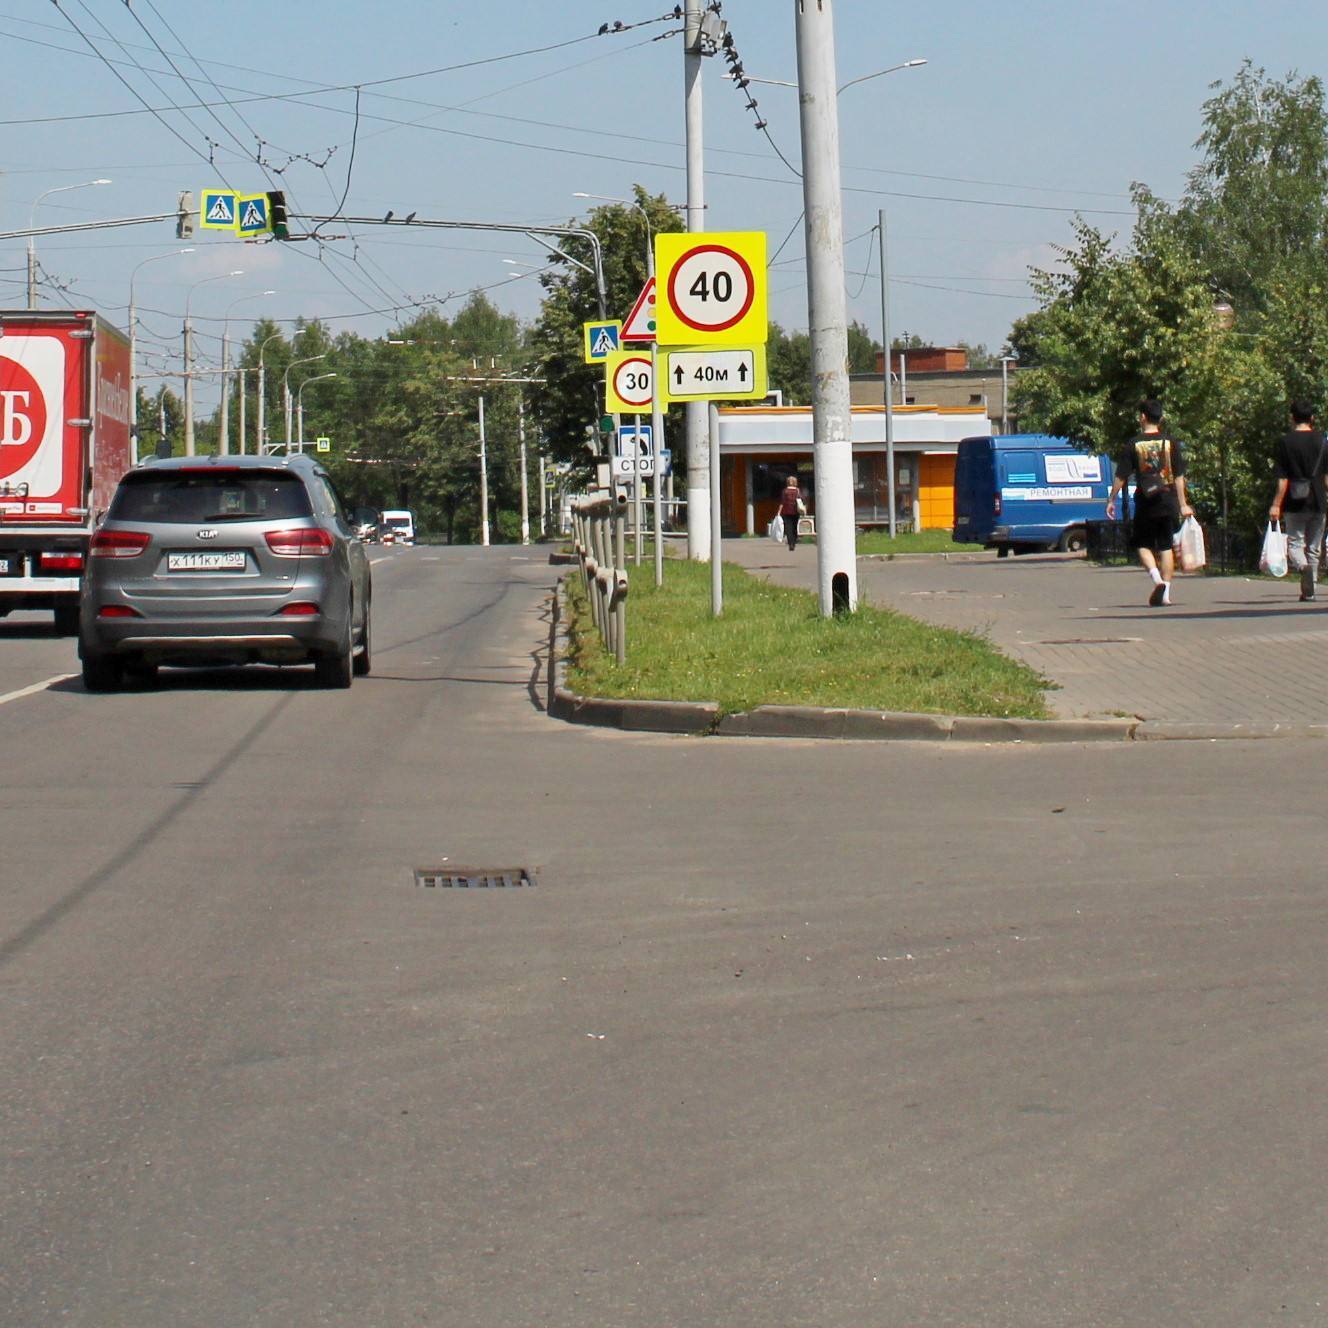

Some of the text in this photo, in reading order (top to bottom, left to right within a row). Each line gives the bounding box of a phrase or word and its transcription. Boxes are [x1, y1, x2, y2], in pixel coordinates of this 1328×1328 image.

[689, 271, 733, 302] 40
[626, 372, 649, 391] 30
[1030, 487, 1089, 498] РЕМОНТНАЯ
[199, 529, 215, 539] KIA
